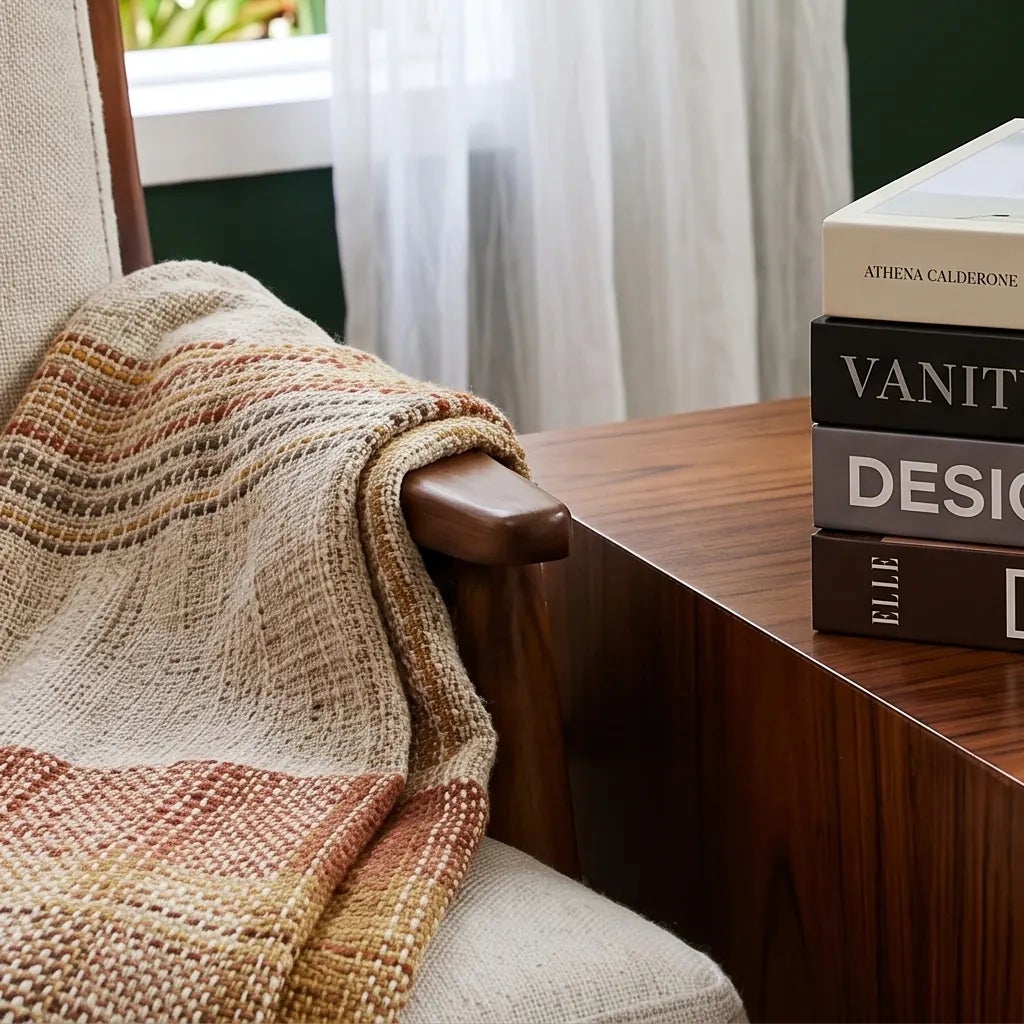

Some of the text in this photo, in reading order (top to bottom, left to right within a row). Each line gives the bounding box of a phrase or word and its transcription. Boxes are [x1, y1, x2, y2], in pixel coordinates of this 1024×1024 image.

[863, 265, 1019, 288] ATHENA CALDERONE
[871, 556, 899, 626] ELLE
